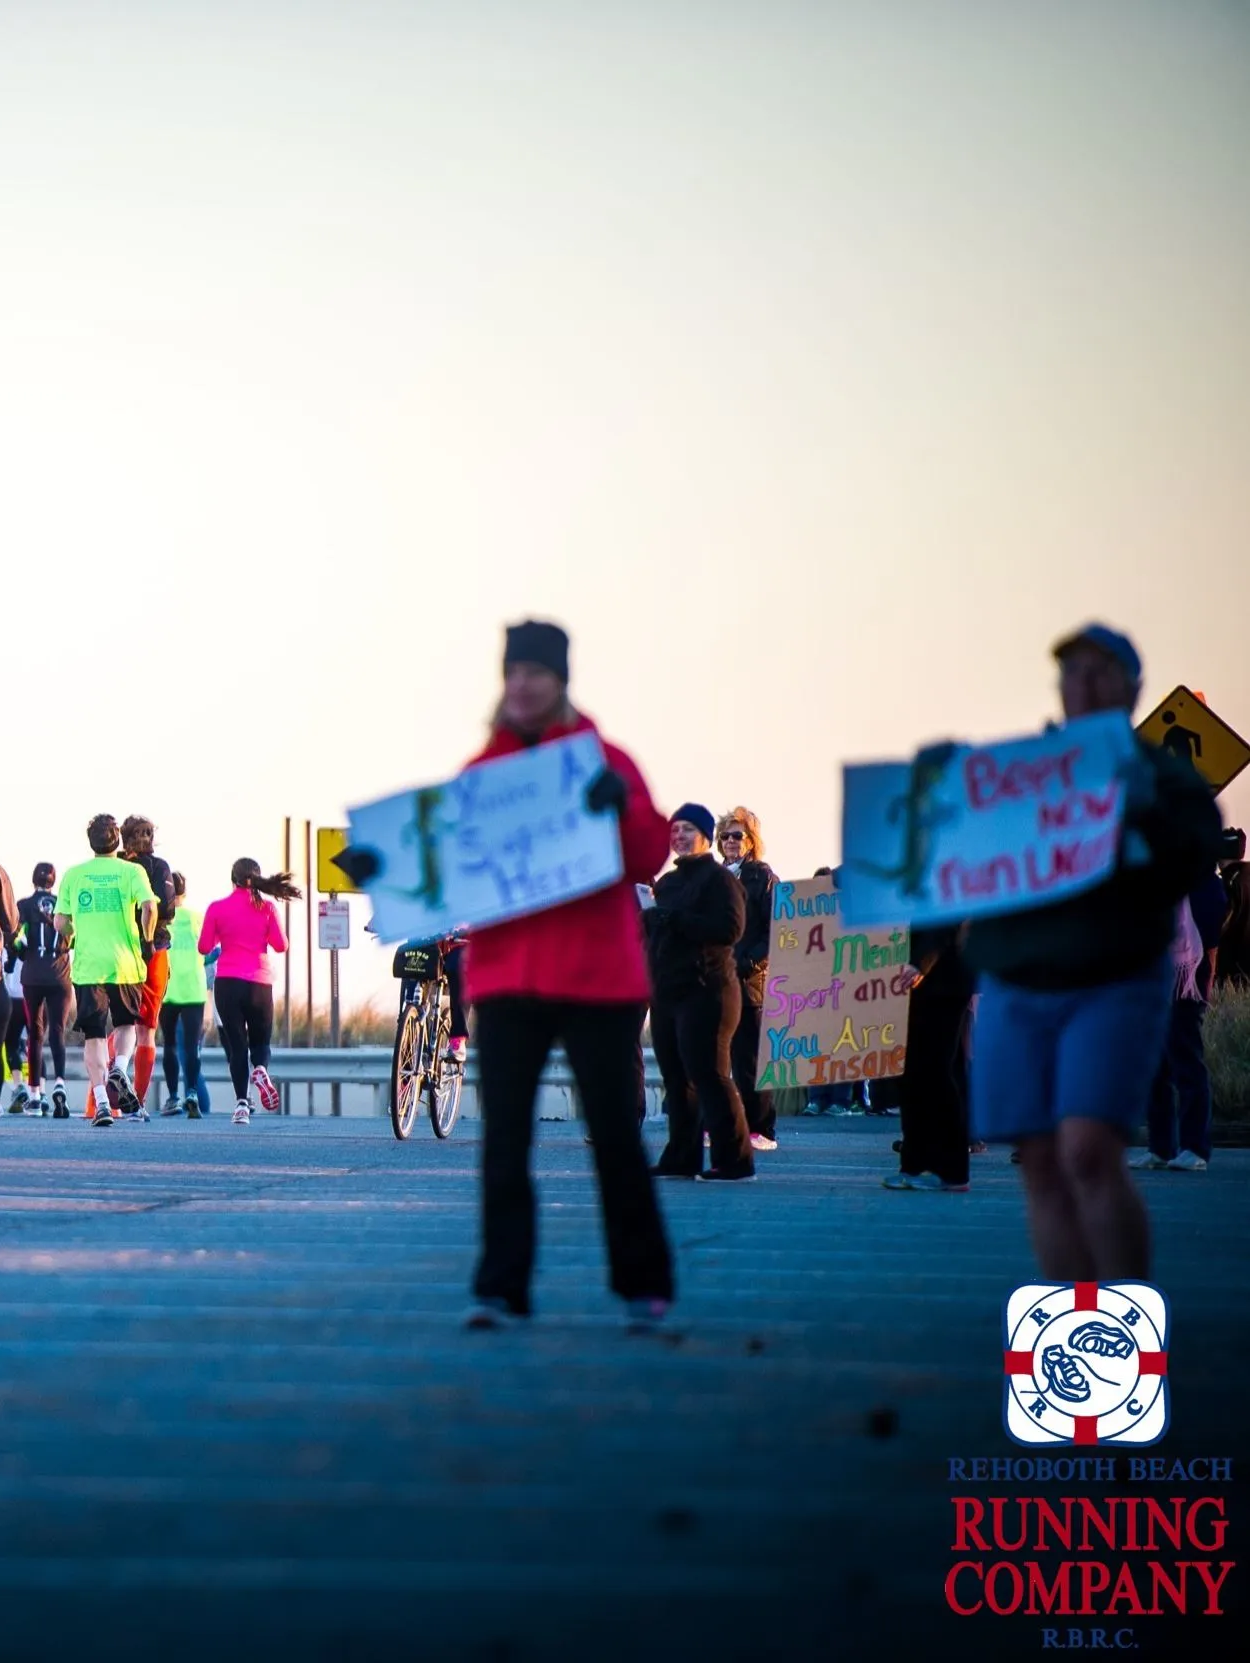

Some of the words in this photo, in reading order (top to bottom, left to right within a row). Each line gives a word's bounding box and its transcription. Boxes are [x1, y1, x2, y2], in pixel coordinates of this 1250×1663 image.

[778, 925, 799, 950] is
[806, 923, 826, 955] A
[765, 974, 845, 1027] Sport
[854, 965, 912, 1002] and
[767, 1026, 822, 1062] You
[832, 1015, 896, 1055] Are
[756, 1059, 800, 1089] All
[808, 1044, 906, 1085] Insane
